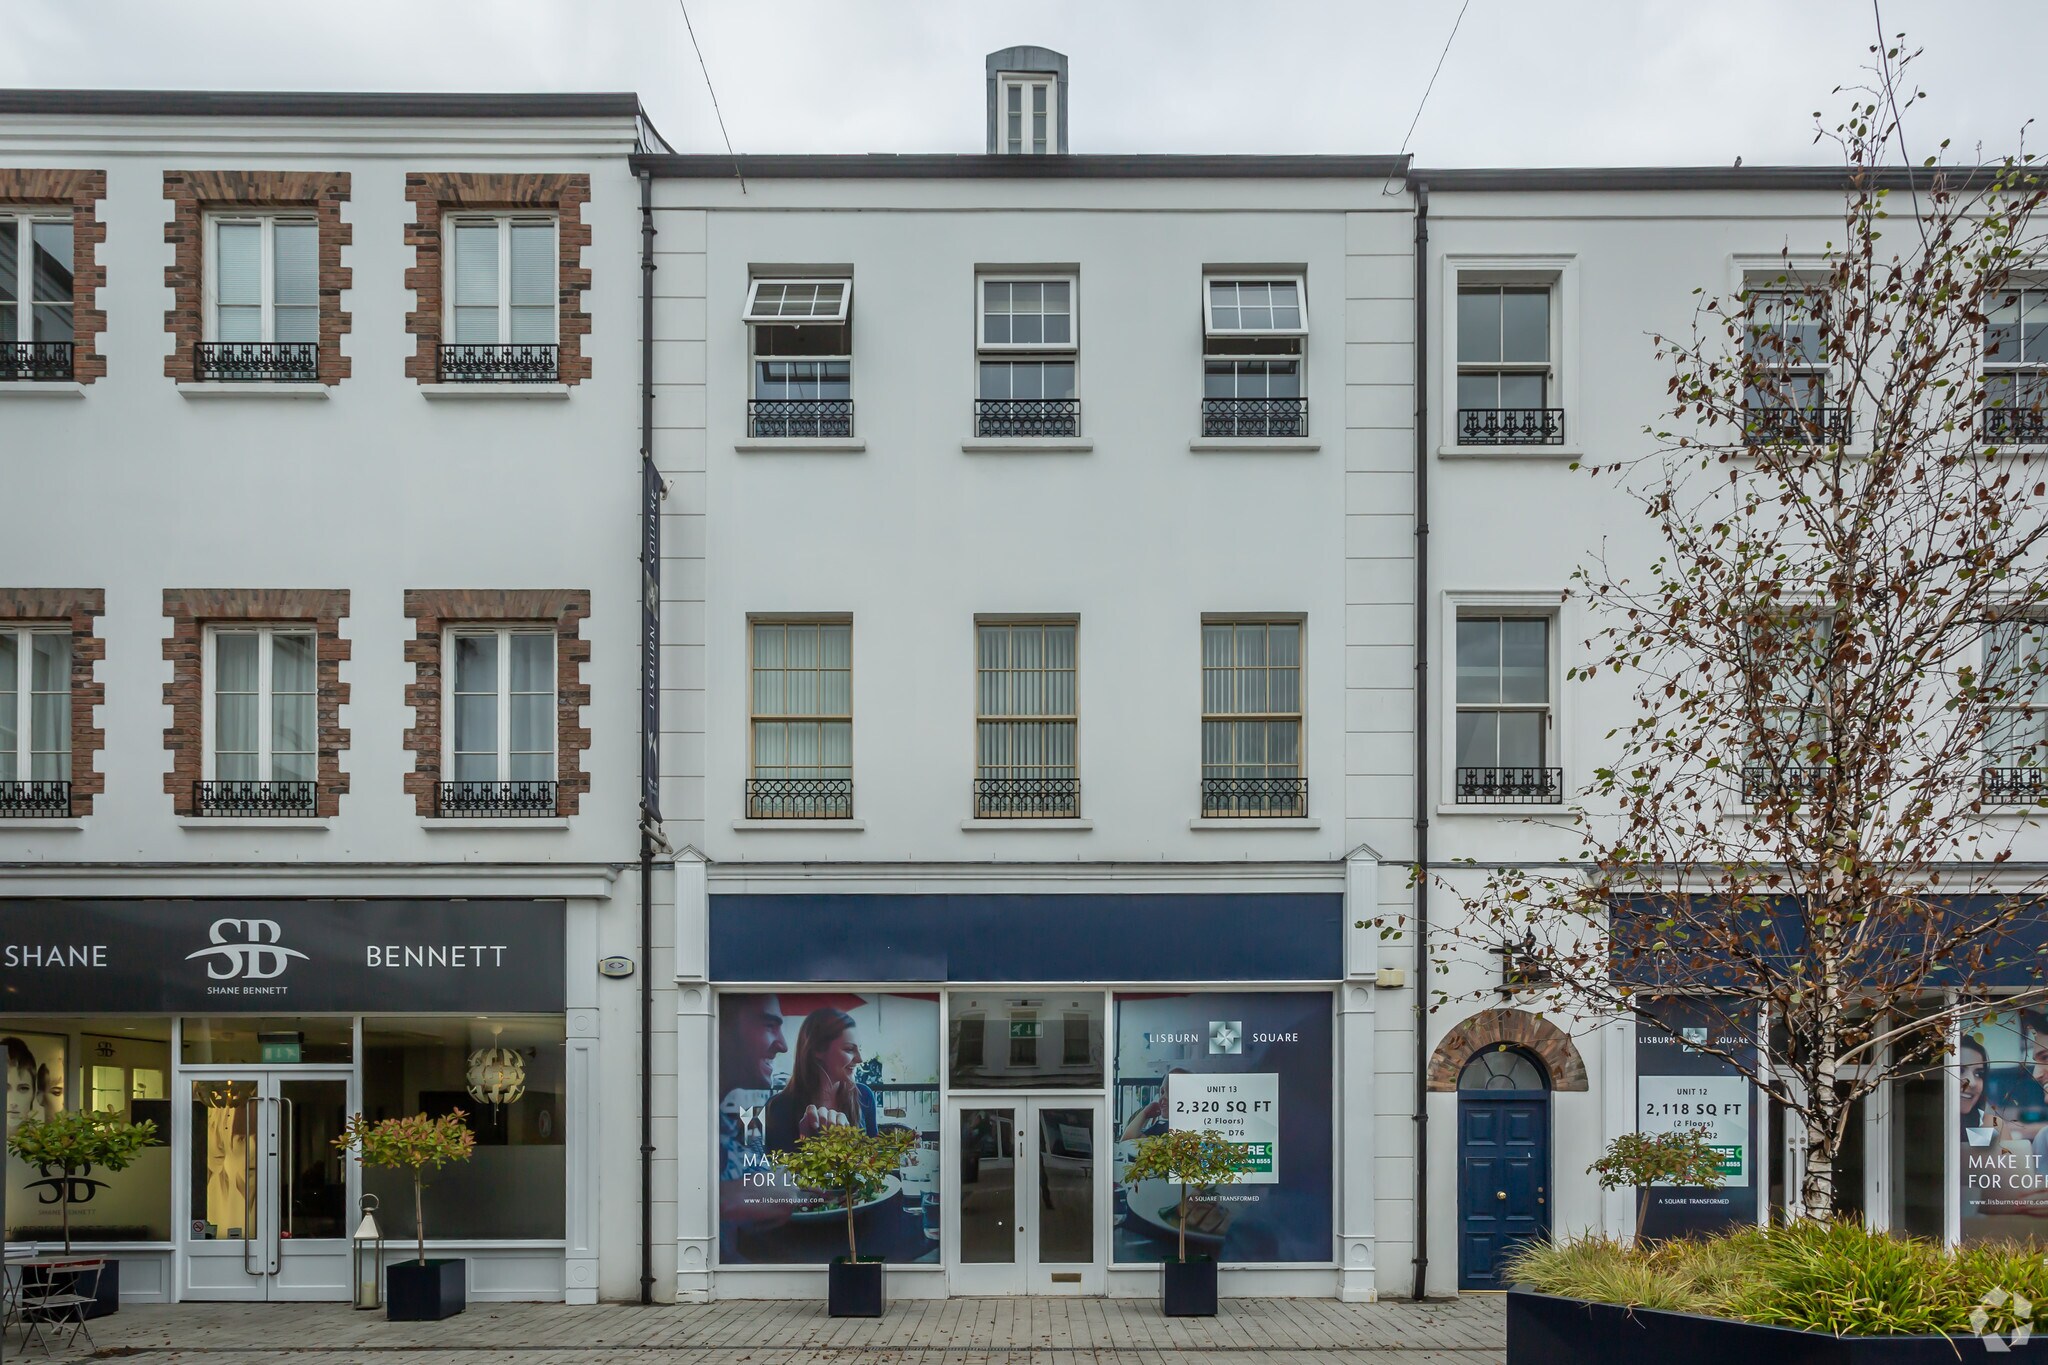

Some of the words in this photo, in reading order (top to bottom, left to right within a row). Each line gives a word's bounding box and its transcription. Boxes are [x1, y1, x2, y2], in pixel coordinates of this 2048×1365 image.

[4, 945, 107, 967] SHANE
[366, 945, 507, 967] BENNETT
[207, 986, 240, 995] SHANE
[243, 986, 288, 995] BENNETT
[1149, 1033, 1199, 1043] LISBURN
[1252, 1032, 1299, 1043] SQUARE
[1207, 1085, 1226, 1093] UNIT
[1229, 1085, 1238, 1093] 13
[1676, 1088, 1696, 1096] UNIT
[1699, 1088, 1708, 1096] 12
[1176, 1101, 1220, 1114] 2,320
[1226, 1101, 1247, 1114] SQ
[1254, 1101, 1272, 1112] FT
[1646, 1103, 1689, 1116] 2,118
[1696, 1103, 1717, 1116] SQ
[1724, 1103, 1742, 1115] FT
[1673, 1120, 1682, 1128] (2
[1685, 1120, 1714, 1128] Floors)
[1228, 1129, 1245, 1137] D76
[1968, 1154, 2017, 1169] MAKE
[2024, 1154, 2043, 1169] IT
[743, 1172, 776, 1187] FOR
[1968, 1174, 2002, 1189] FOR
[743, 1196, 825, 1204] www.lisburnsquare.com
